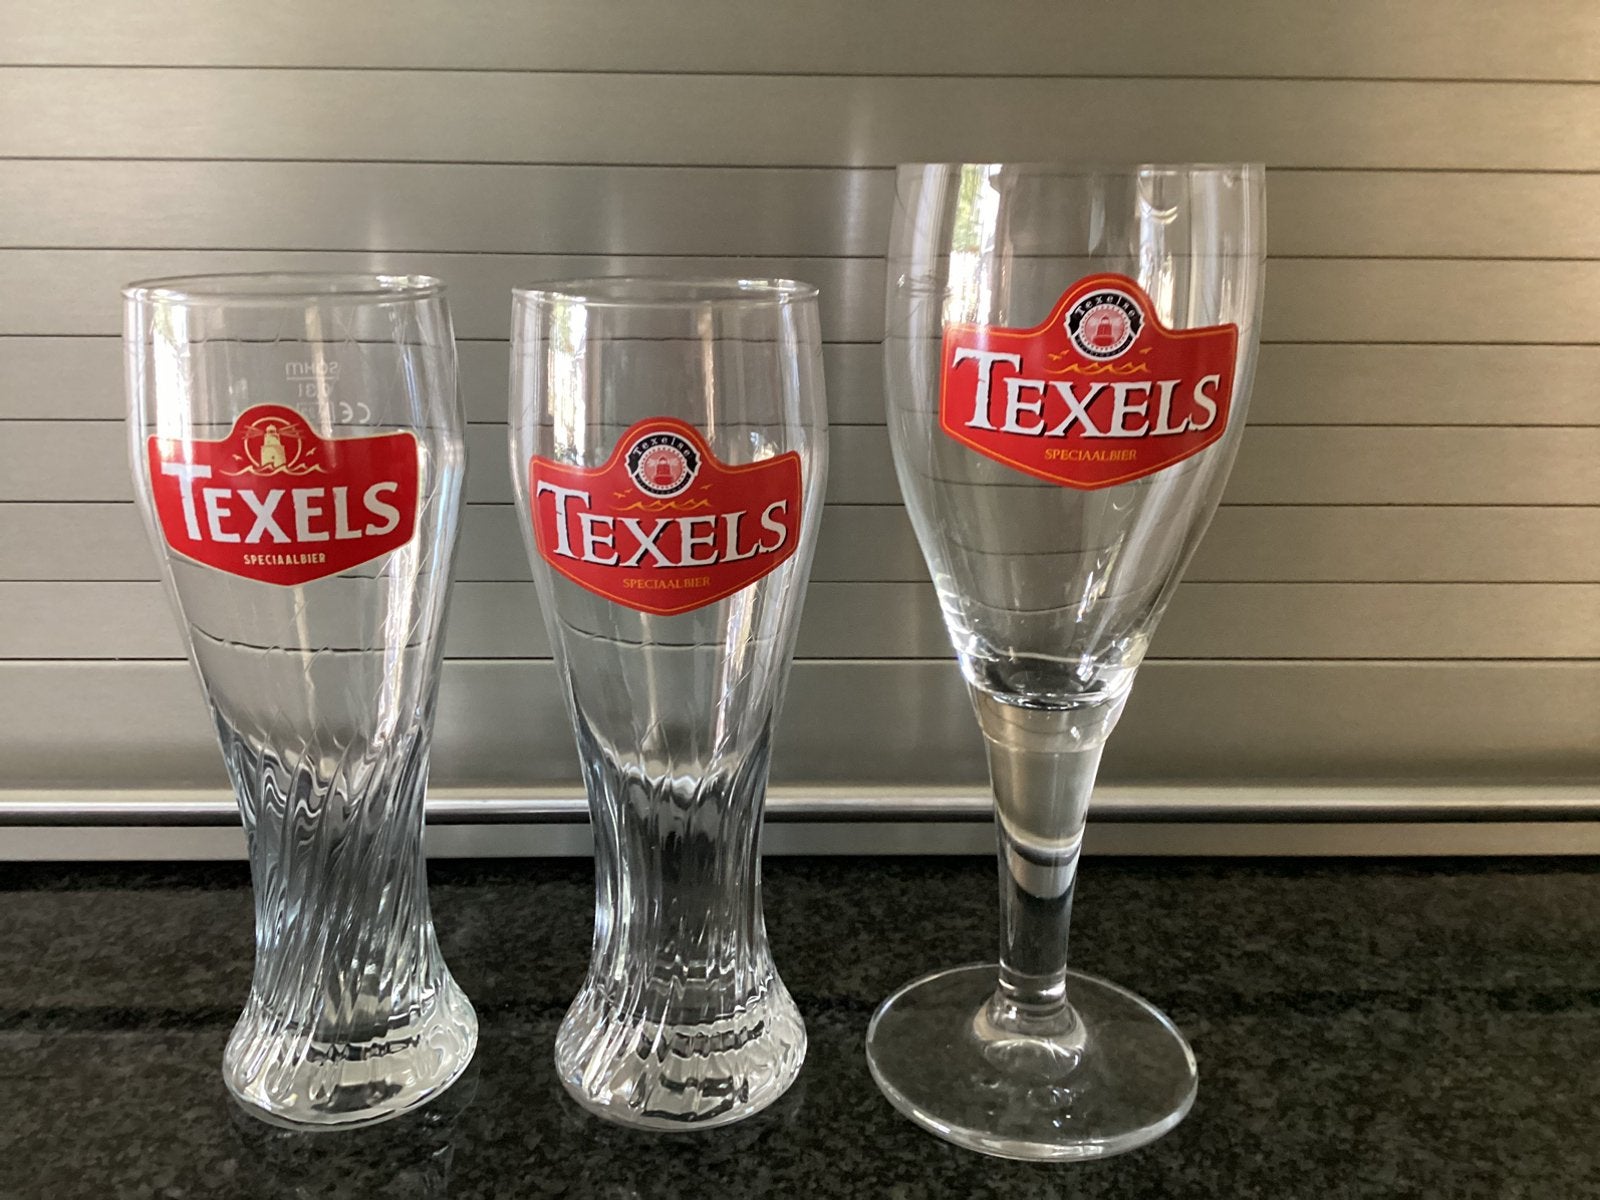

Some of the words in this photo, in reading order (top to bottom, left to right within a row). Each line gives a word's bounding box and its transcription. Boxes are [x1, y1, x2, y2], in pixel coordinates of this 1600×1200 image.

[1075, 296, 1135, 317] Texelse
[952, 347, 1220, 437] TEXELS
[632, 436, 691, 457] Texelse
[1045, 448, 1137, 461] SPECIAALBIER
[161, 463, 401, 544] TEXELS
[536, 480, 788, 567] TEXELS
[243, 553, 326, 565] SPECIAALBIER
[623, 576, 711, 589] SPECIAALBIER
